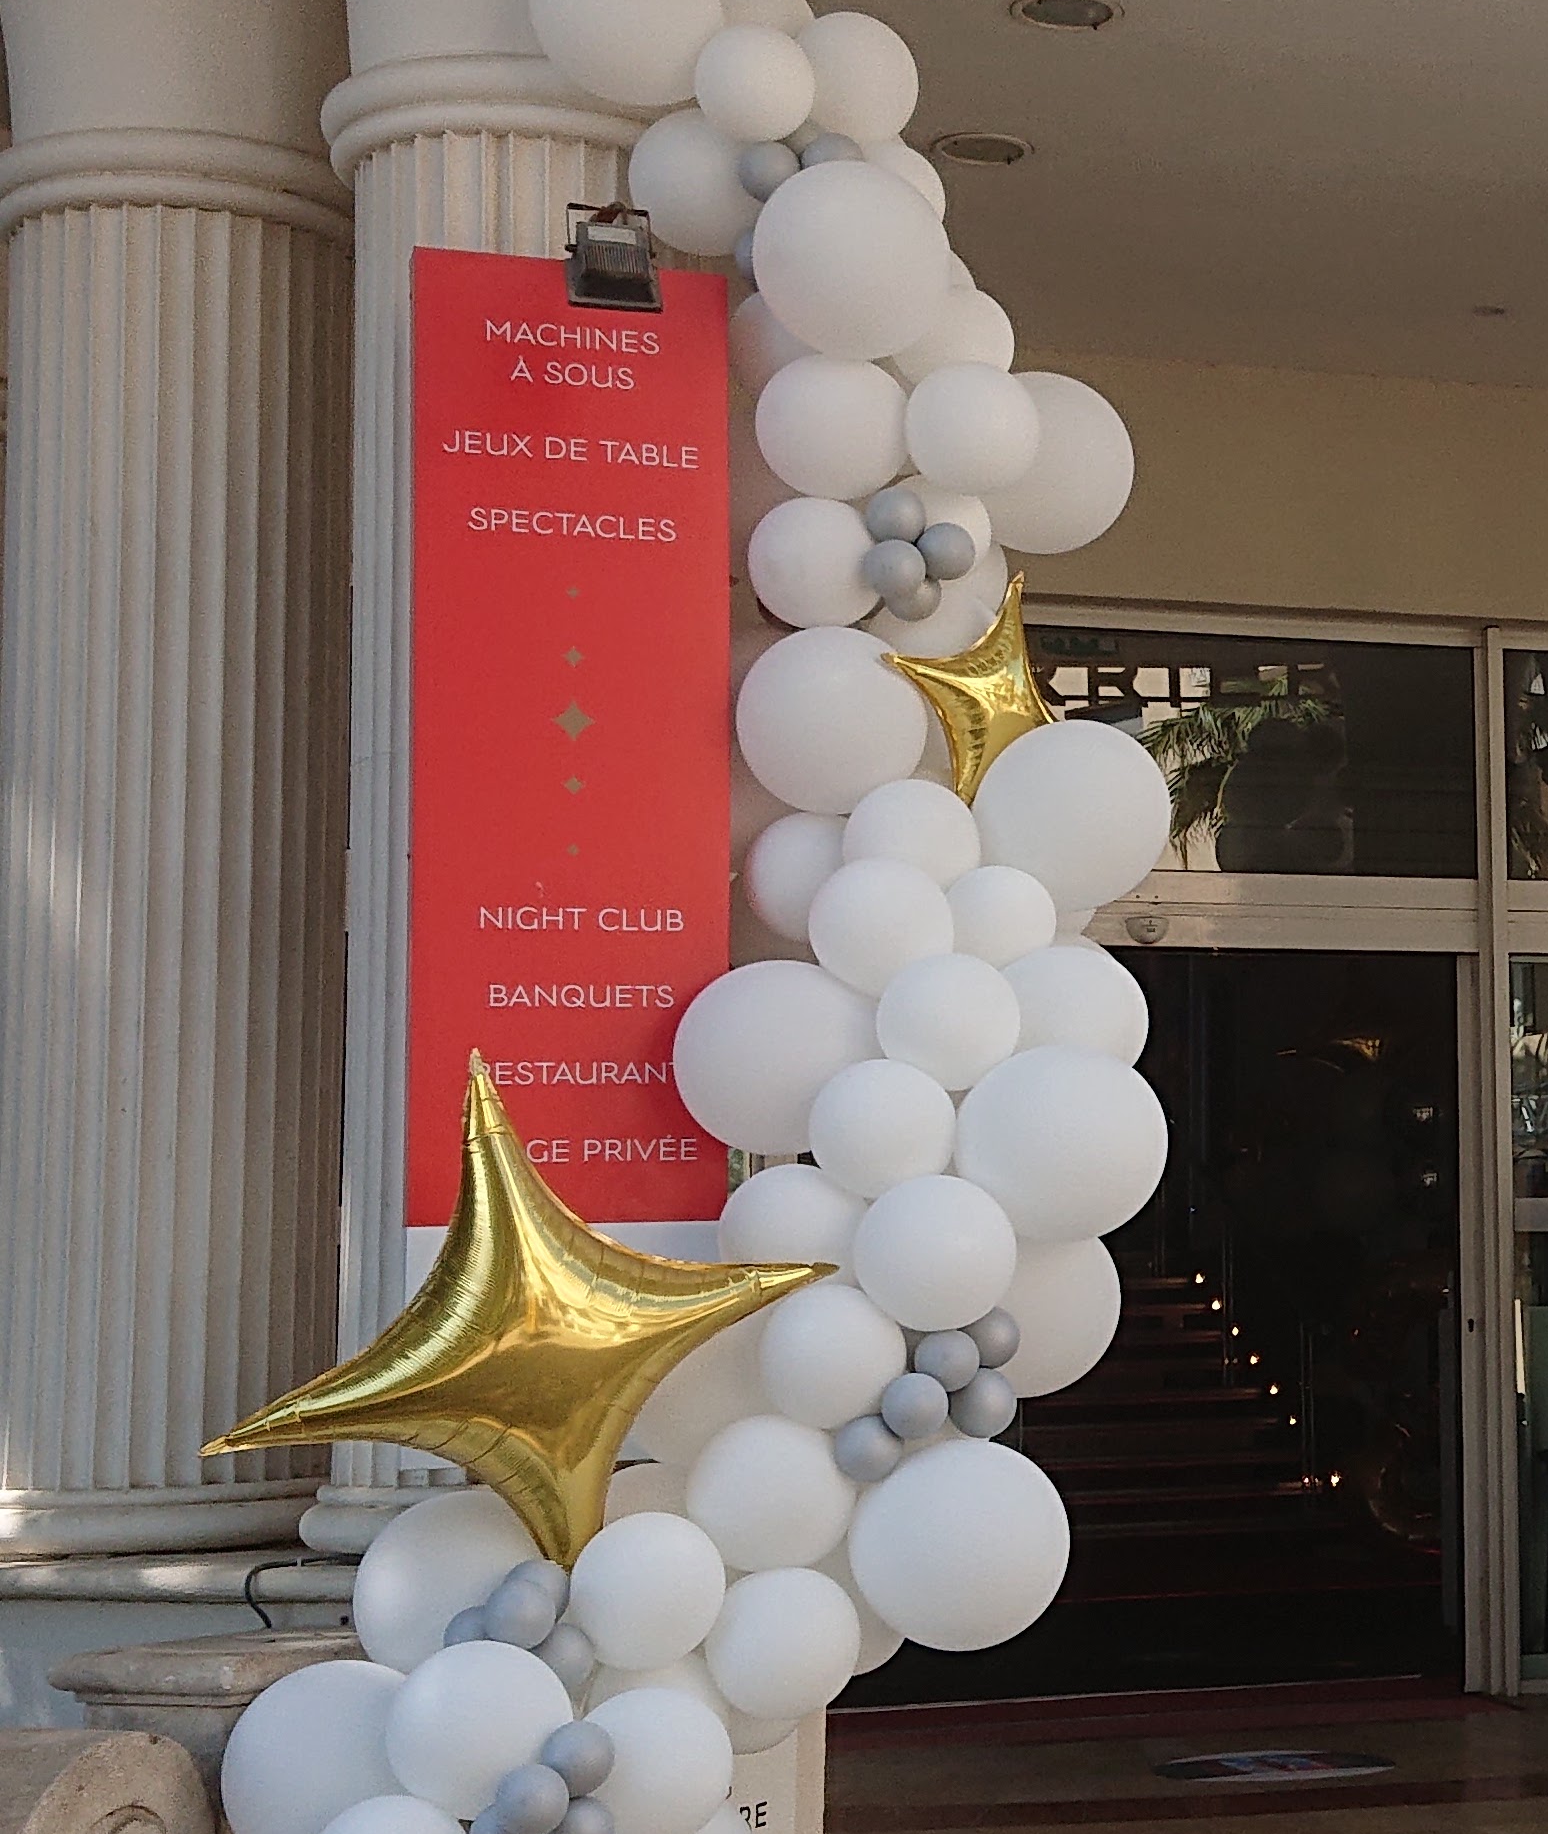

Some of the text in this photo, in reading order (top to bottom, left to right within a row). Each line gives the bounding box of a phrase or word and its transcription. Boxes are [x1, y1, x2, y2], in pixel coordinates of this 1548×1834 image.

[485, 319, 661, 355] MACHINES
[510, 356, 636, 390] À SOUS
[442, 430, 700, 469] JEUX DE TABLE
[467, 507, 677, 542] SPECTACLES
[478, 906, 685, 932] NIGHT CLUB
[488, 983, 675, 1010] BANQUETS
[583, 1134, 698, 1163] PRIVÉE
